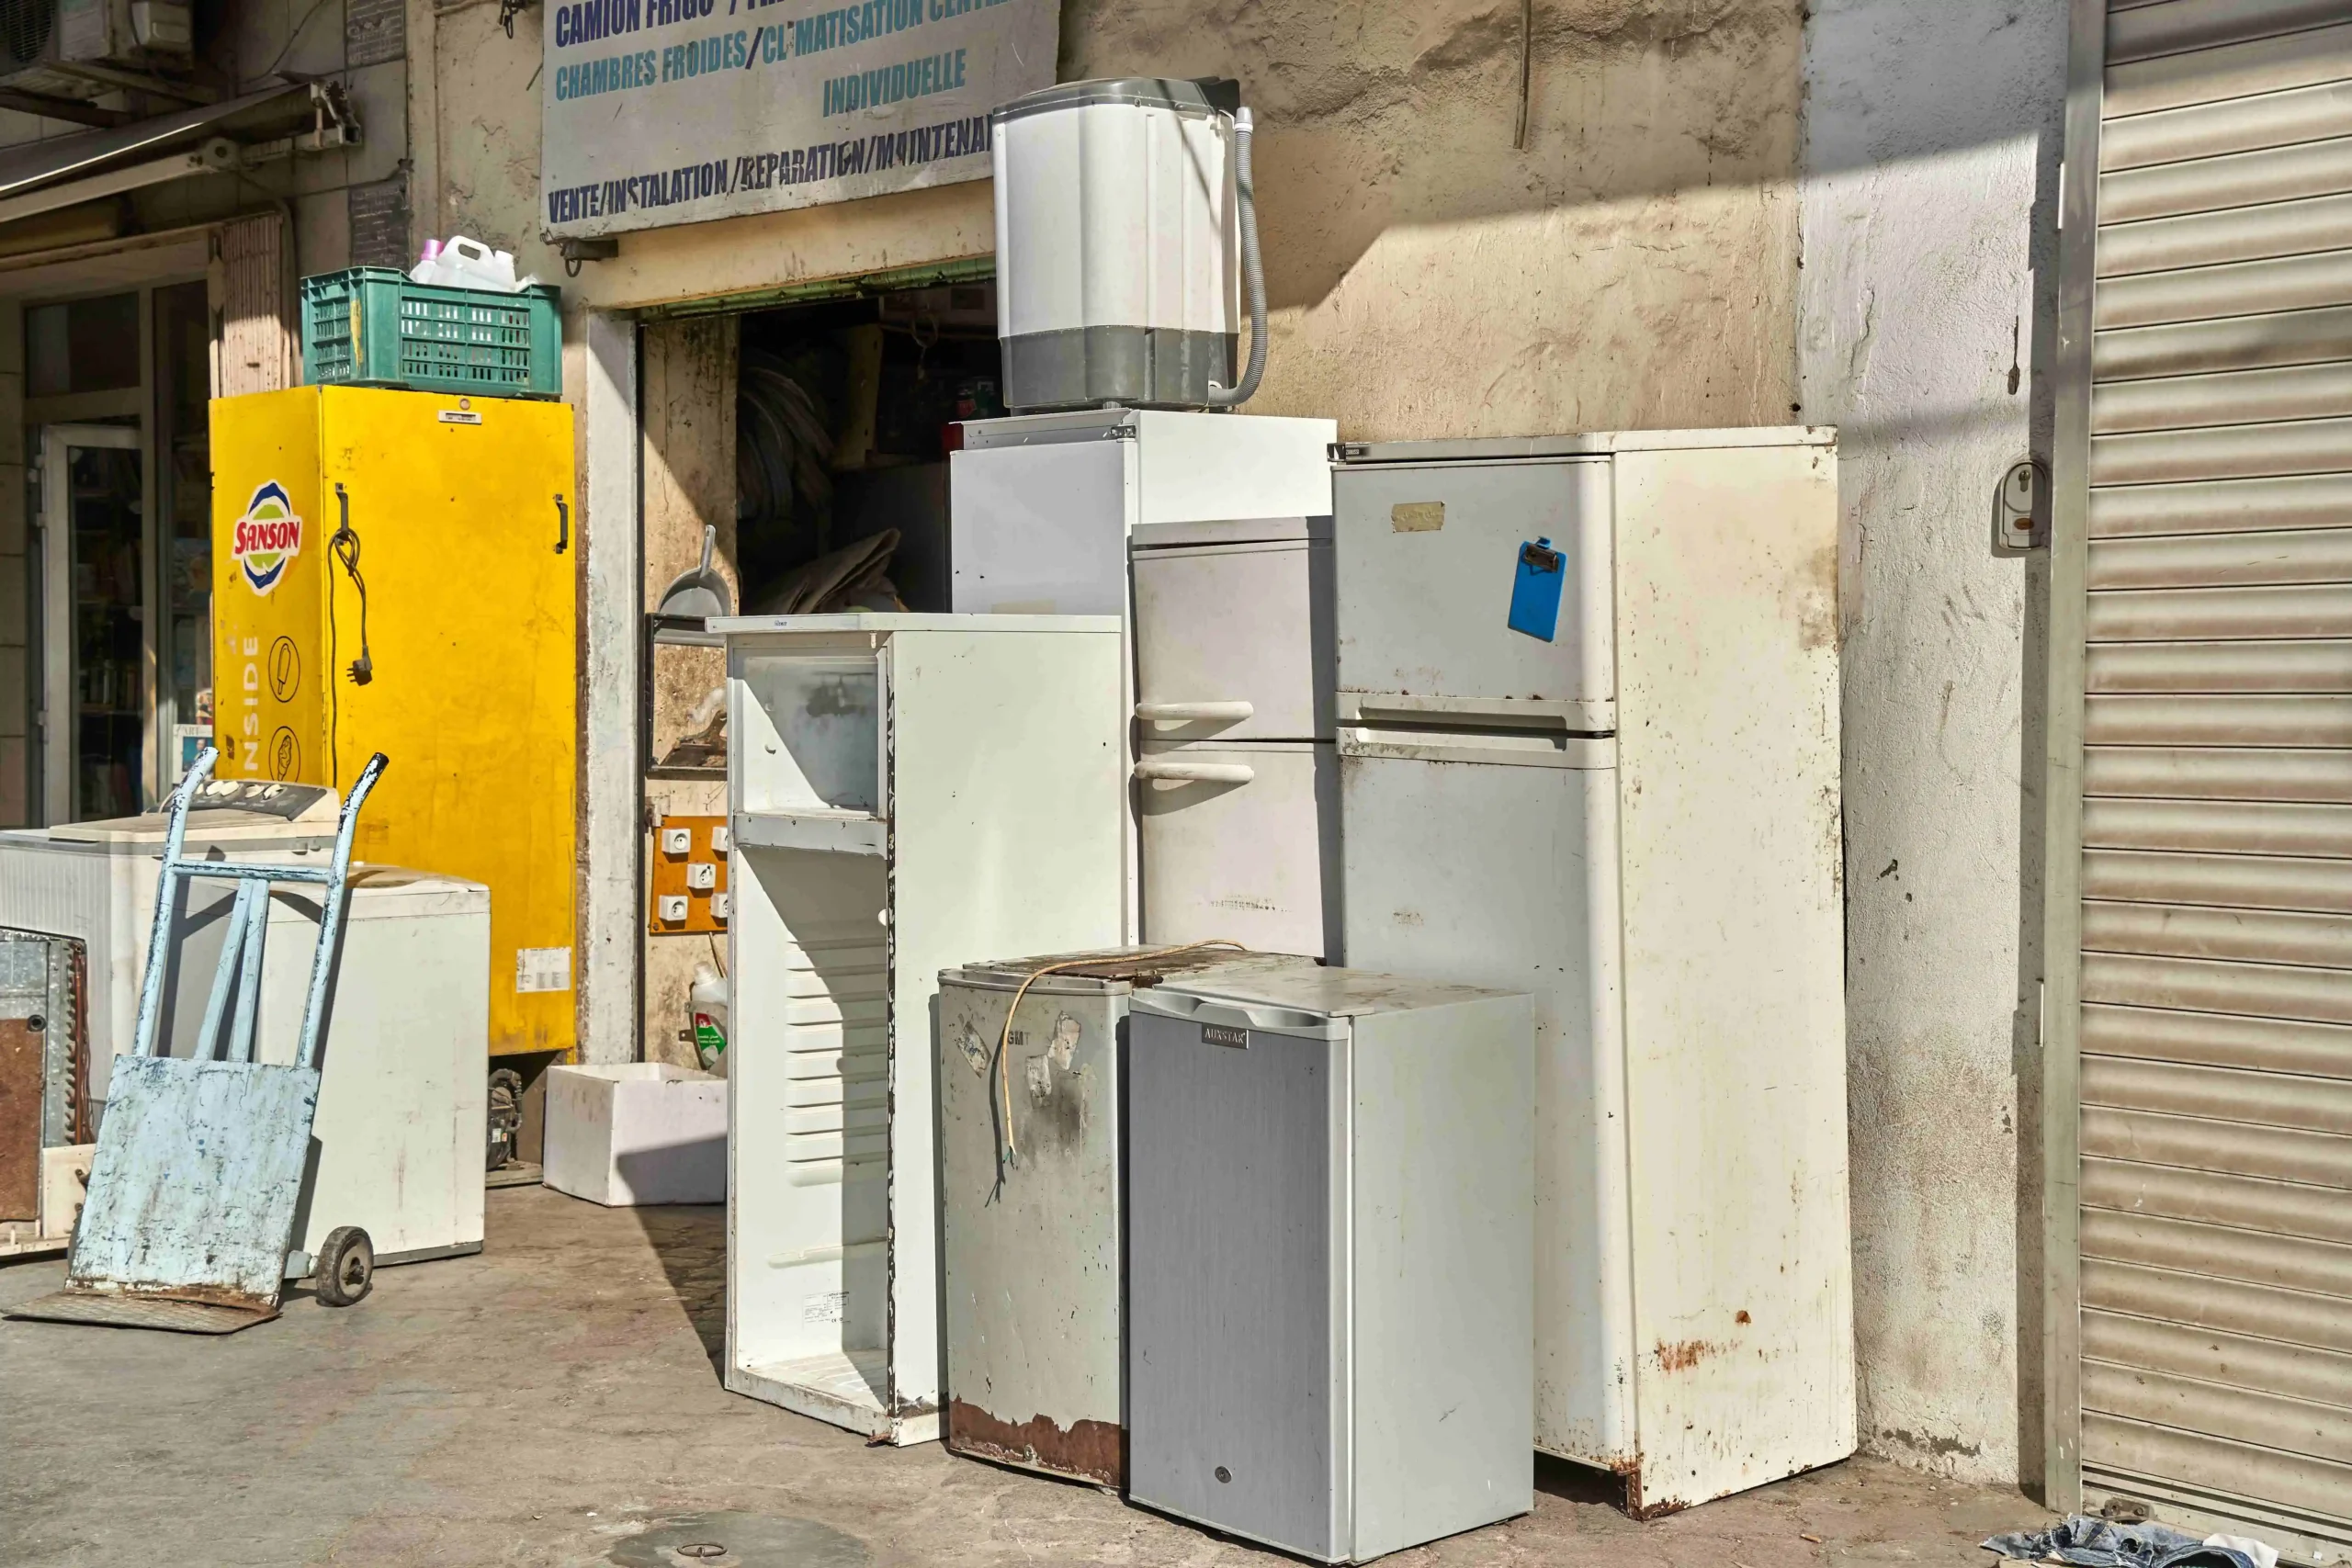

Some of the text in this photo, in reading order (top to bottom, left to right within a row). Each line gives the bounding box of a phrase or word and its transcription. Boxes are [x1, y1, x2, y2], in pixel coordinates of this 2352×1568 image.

[556, 0, 640, 47] CAMION
[556, 0, 923, 101] CHAMBRES FROIDES/CLMATISATION
[823, 49, 966, 118] INDIVIDUELLE
[234, 521, 300, 555] SANSON
